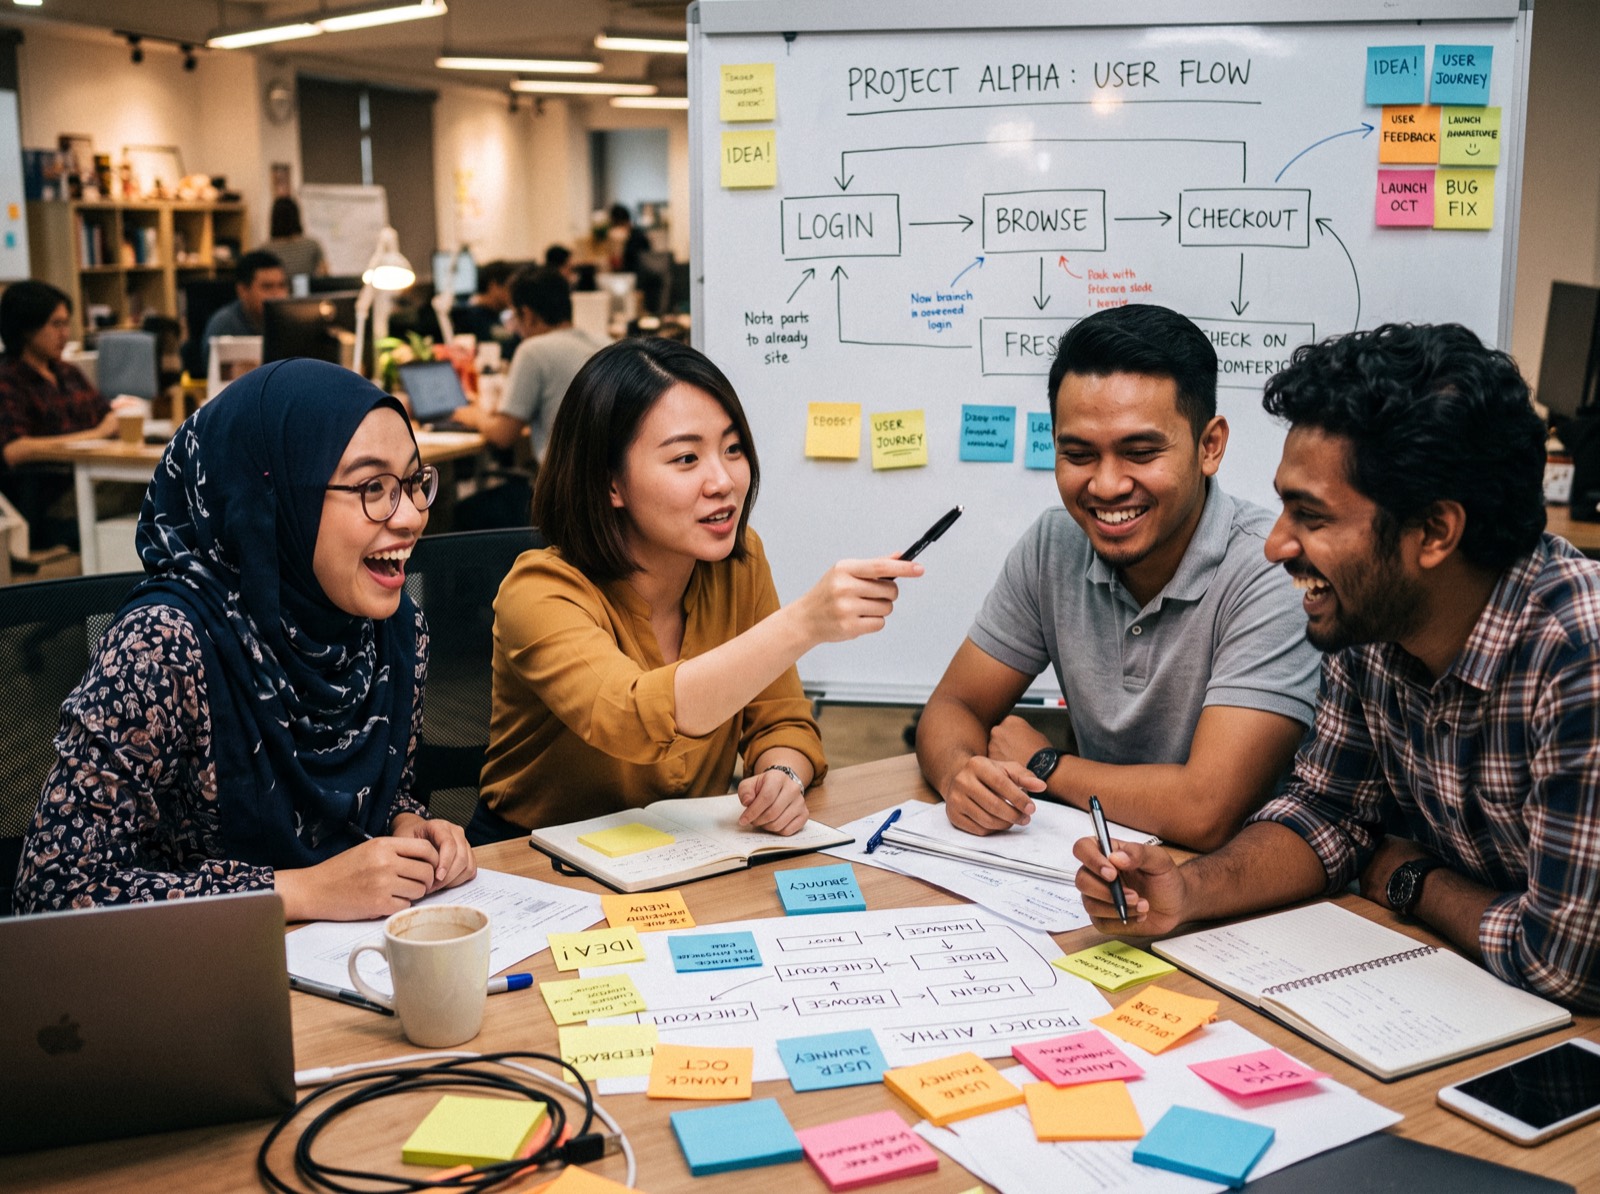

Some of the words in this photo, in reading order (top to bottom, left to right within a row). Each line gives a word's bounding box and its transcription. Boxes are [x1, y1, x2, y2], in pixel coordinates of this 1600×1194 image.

[1375, 56, 1417, 75] IDEA!
[1443, 54, 1475, 66] USER
[849, 67, 959, 102] PROJECT
[1095, 61, 1159, 88] USER
[1180, 59, 1250, 87] FLOW
[1436, 72, 1487, 89] JOURNEY
[1392, 115, 1414, 123] USER
[1449, 116, 1480, 124] LAUNCH
[1384, 132, 1436, 142] FEEDBACK
[728, 142, 769, 163] IDEA!
[1382, 183, 1426, 194] LAUNCH
[1447, 180, 1478, 195] BUG
[1391, 200, 1418, 211] OCT
[1449, 201, 1476, 216] FIX
[799, 212, 873, 240] LOGIN
[997, 208, 1087, 234] BROWSE
[1188, 207, 1298, 231] CHECKOUT
[1112, 268, 1137, 279] with
[911, 294, 931, 303] Now
[780, 310, 809, 330] parts
[928, 321, 952, 332] login
[747, 333, 759, 346] to
[766, 331, 807, 349] already
[1264, 334, 1286, 347] ON
[765, 350, 789, 364] site
[875, 419, 904, 431] USER
[878, 434, 922, 448] JOURNEY
[563, 940, 633, 960] IDEA!
[785, 961, 874, 976] CHECKOUT
[951, 983, 1015, 998] LOGIN
[808, 994, 886, 1009] BROWSE
[654, 1010, 748, 1025] CHECKOUT
[990, 1016, 1080, 1033] PROJECT
[567, 1047, 654, 1065] FEEDBACK
[680, 1059, 729, 1070] OCT
[817, 1060, 872, 1076] USER
[1229, 1061, 1271, 1073] FIX
